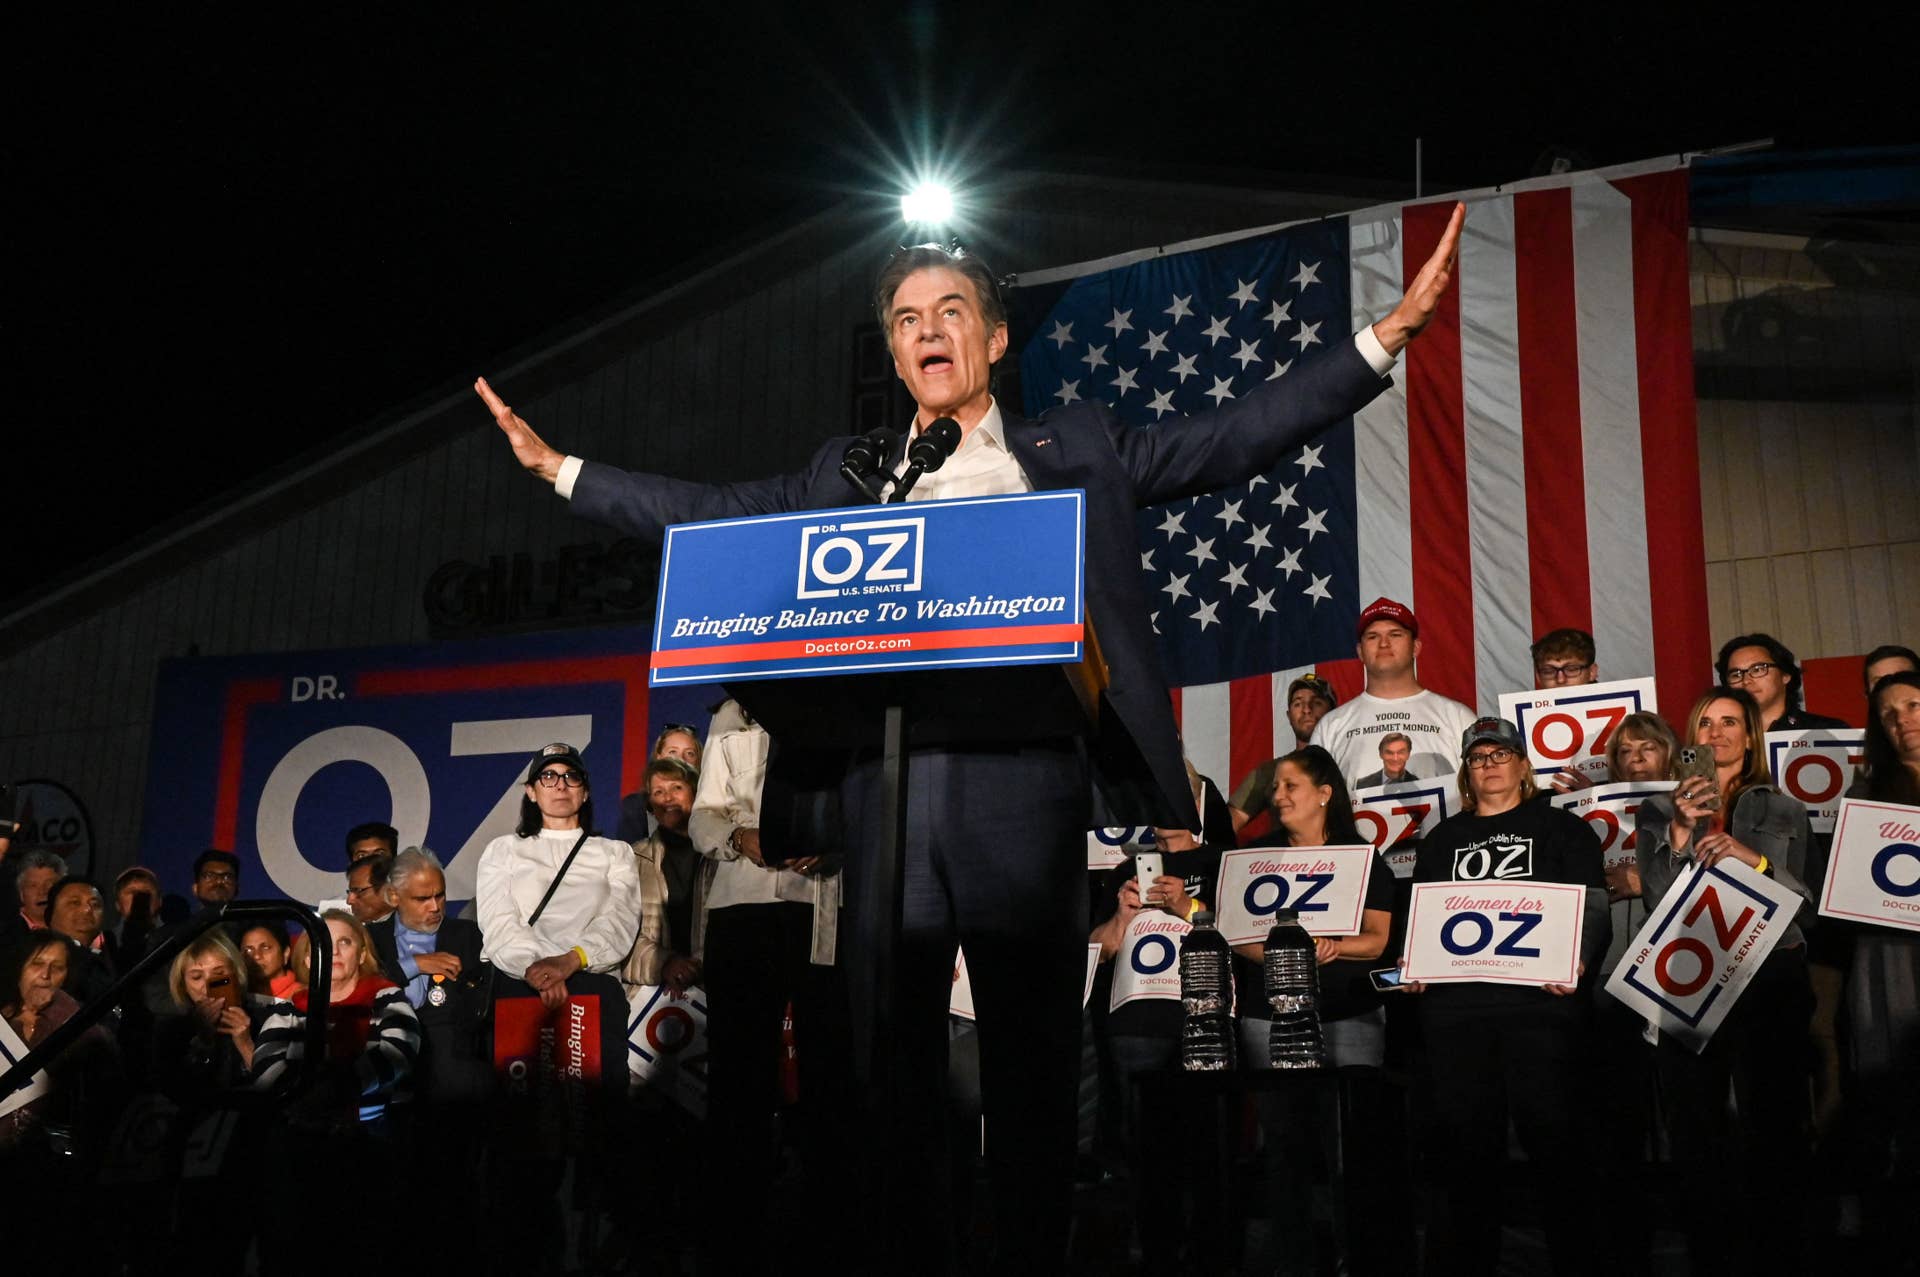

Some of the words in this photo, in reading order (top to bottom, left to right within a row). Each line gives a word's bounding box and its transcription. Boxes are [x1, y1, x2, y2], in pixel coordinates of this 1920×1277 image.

[821, 525, 839, 533] DR.
[811, 532, 909, 585] OZ
[842, 586, 861, 596] U.S.
[863, 583, 902, 595] SENATE
[671, 613, 773, 638] Bringing
[775, 604, 870, 630] Balance
[876, 601, 907, 622] To
[916, 593, 1066, 620] Washington
[805, 636, 912, 655] DoctorOz.com
[290, 674, 346, 703] DR.
[1535, 700, 1552, 709] DR.
[1363, 723, 1401, 735] MEHMET
[1403, 723, 1441, 734] MONDAY
[1532, 706, 1627, 760] OZ
[1791, 740, 1811, 749] DR.
[1590, 761, 1609, 770] SEN
[1580, 797, 1596, 807] DR.
[1249, 859, 1311, 875] Women
[1307, 859, 1337, 878] for
[1458, 844, 1527, 880] OZ
[1243, 873, 1335, 916] OZ
[1445, 895, 1514, 911] Women
[1510, 897, 1545, 916] for
[1133, 919, 1193, 937] Women
[1440, 911, 1543, 958] OZ
[1654, 884, 1756, 997] OZ
[1635, 946, 1653, 965] DR.
[1719, 964, 1738, 984] U.S.
[1734, 921, 1766, 963] SENATE
[1451, 959, 1524, 969] DOCTOROZ.COM
[567, 1003, 586, 1080] Bringing
